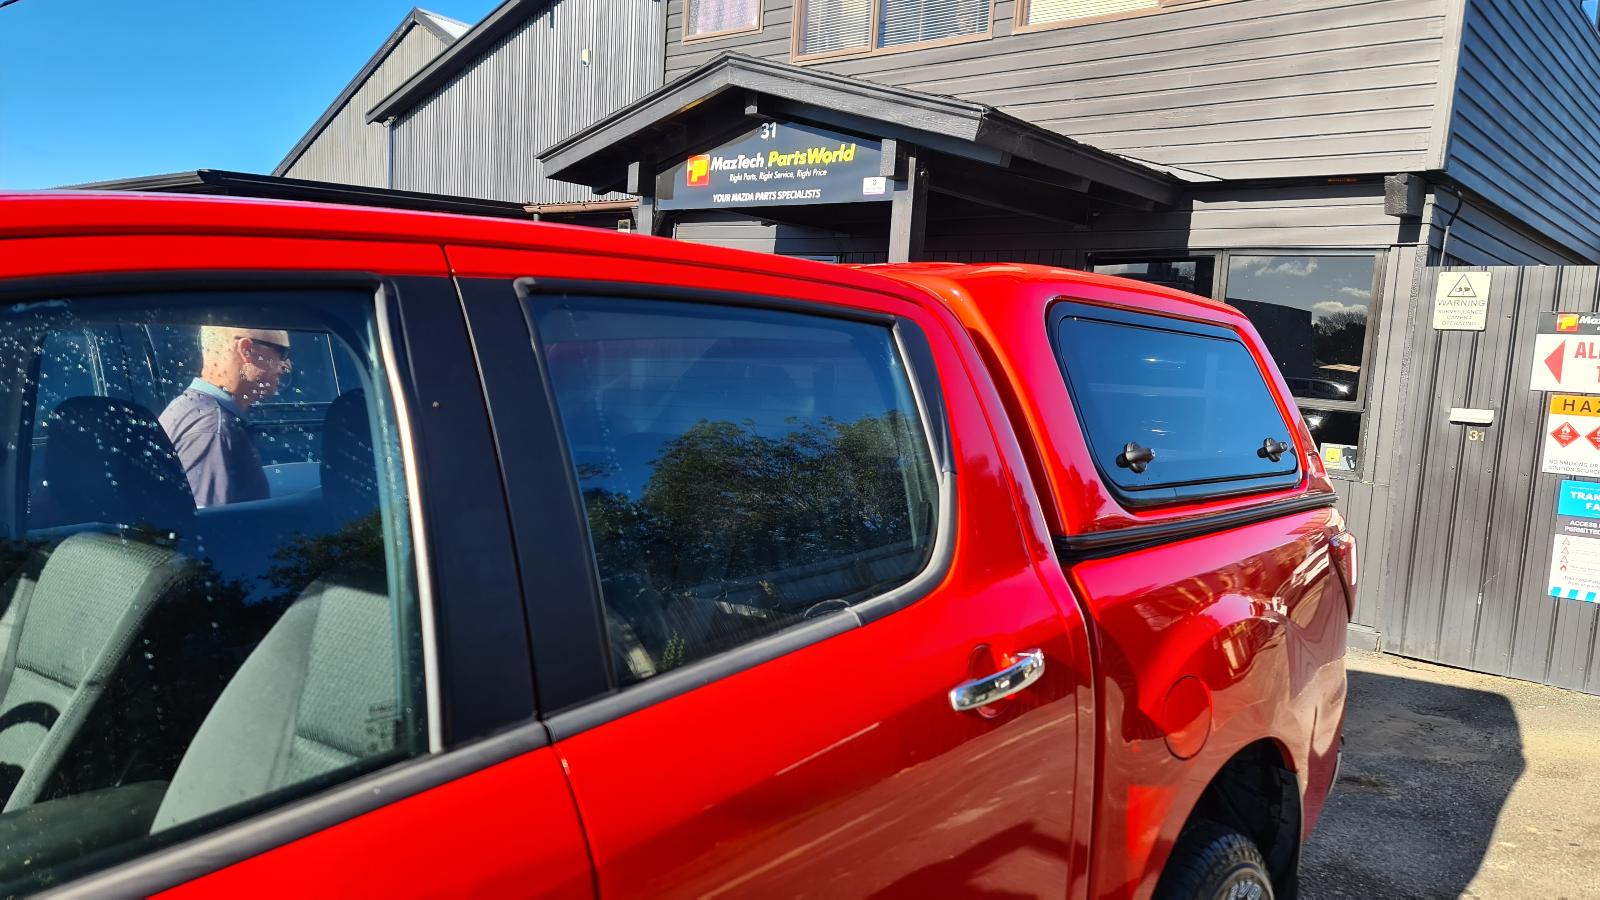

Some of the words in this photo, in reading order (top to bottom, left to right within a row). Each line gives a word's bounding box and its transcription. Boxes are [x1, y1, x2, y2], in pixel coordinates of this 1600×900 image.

[760, 122, 777, 140] 31
[710, 152, 765, 171] MazTech
[767, 143, 856, 168] PartsWorld
[729, 173, 742, 183] Right
[759, 171, 773, 181] Right
[773, 169, 794, 179] Service,
[796, 168, 811, 179] Right
[812, 168, 828, 176] Price
[712, 193, 731, 202] YOUR
[731, 192, 754, 202] MAZDA
[755, 191, 777, 200] PARTS
[777, 188, 822, 200] SPECIALISTS
[1468, 430, 1485, 442] 31
